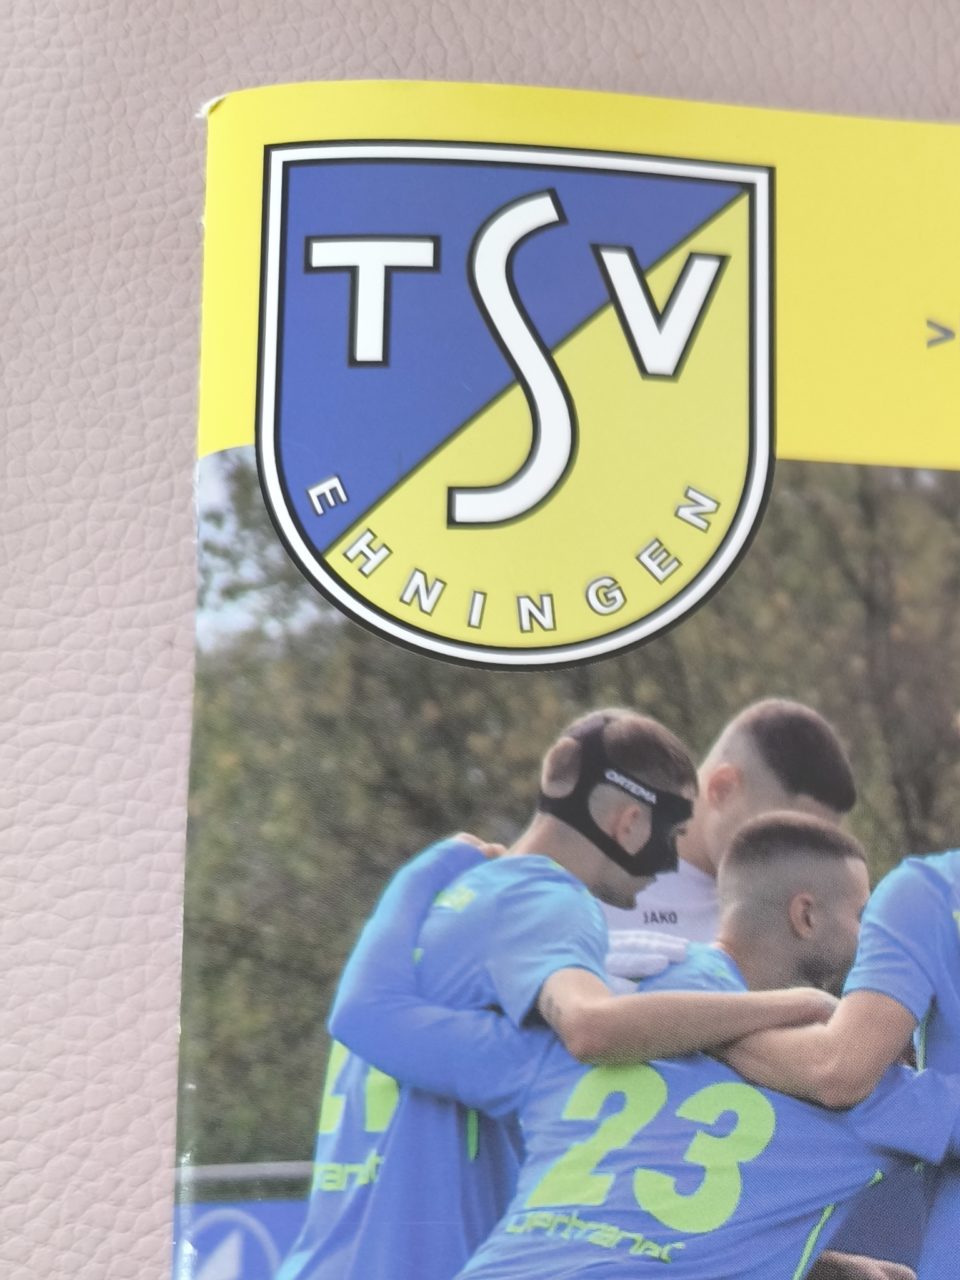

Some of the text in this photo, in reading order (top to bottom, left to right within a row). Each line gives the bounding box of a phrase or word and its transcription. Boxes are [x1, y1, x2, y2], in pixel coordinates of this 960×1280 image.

[305, 187, 732, 530] TSV
[306, 474, 722, 634] EHNINGEN
[642, 910, 679, 926] JAKO
[526, 1062, 776, 1234] 23
